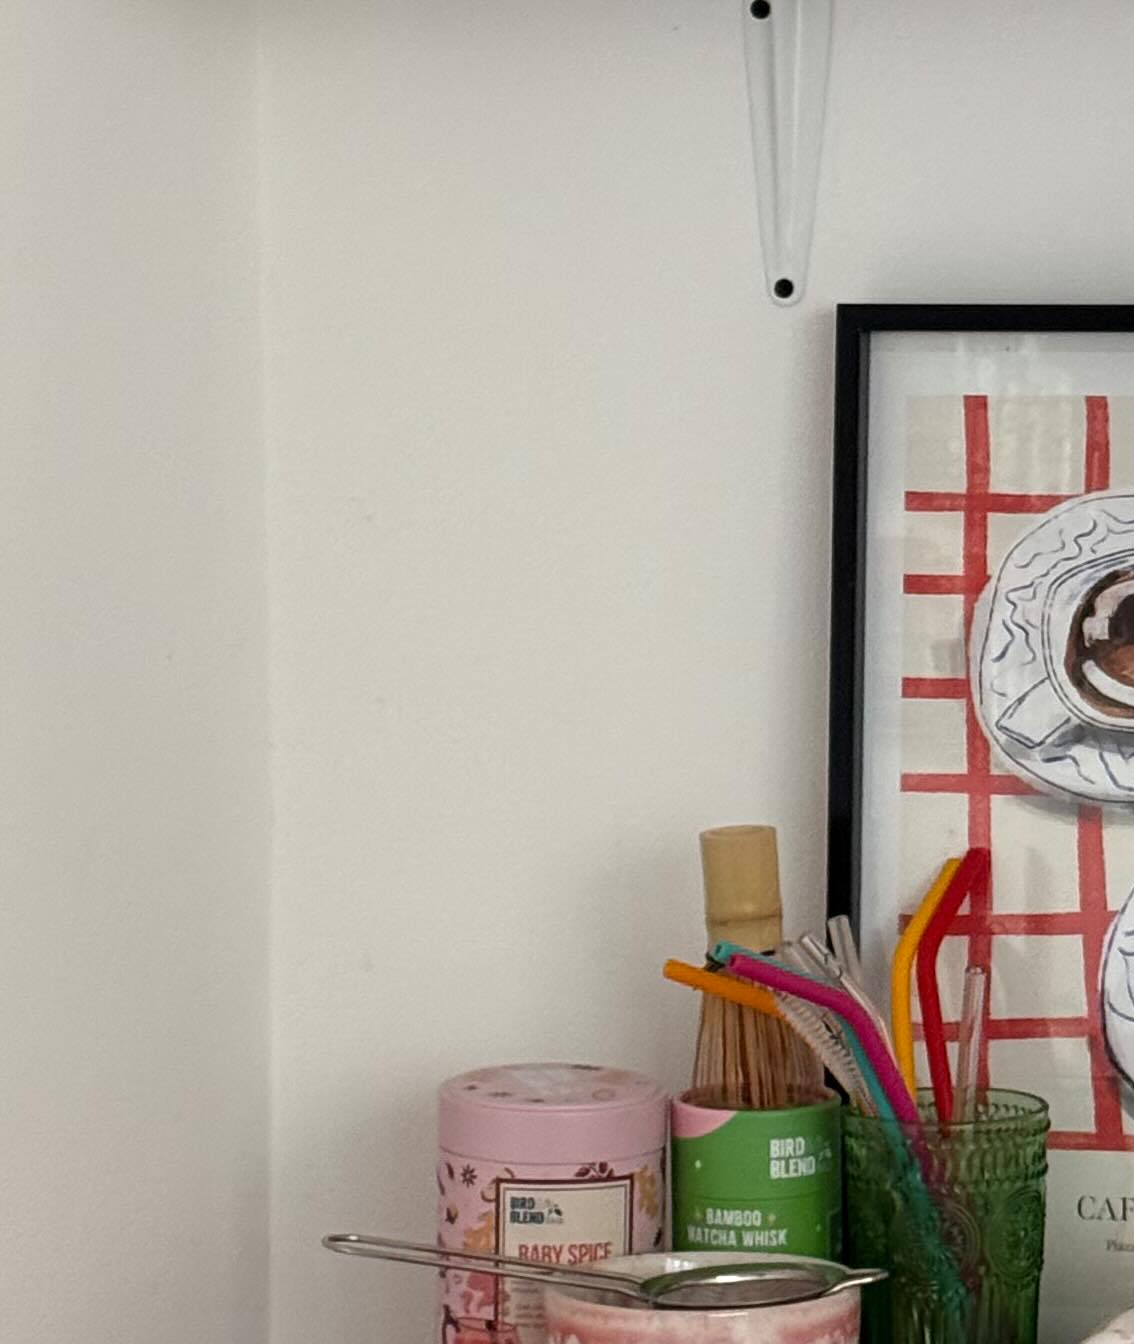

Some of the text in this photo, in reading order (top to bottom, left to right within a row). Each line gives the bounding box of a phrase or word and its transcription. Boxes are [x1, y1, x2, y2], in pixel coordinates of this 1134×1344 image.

[769, 1136, 806, 1159] BIRD
[769, 1156, 816, 1180] BLEND
[510, 1196, 536, 1210] BIRD
[510, 1210, 545, 1224] BLEND
[705, 1208, 763, 1227] BAMBOO
[687, 1225, 788, 1247] MATCHA WHISK
